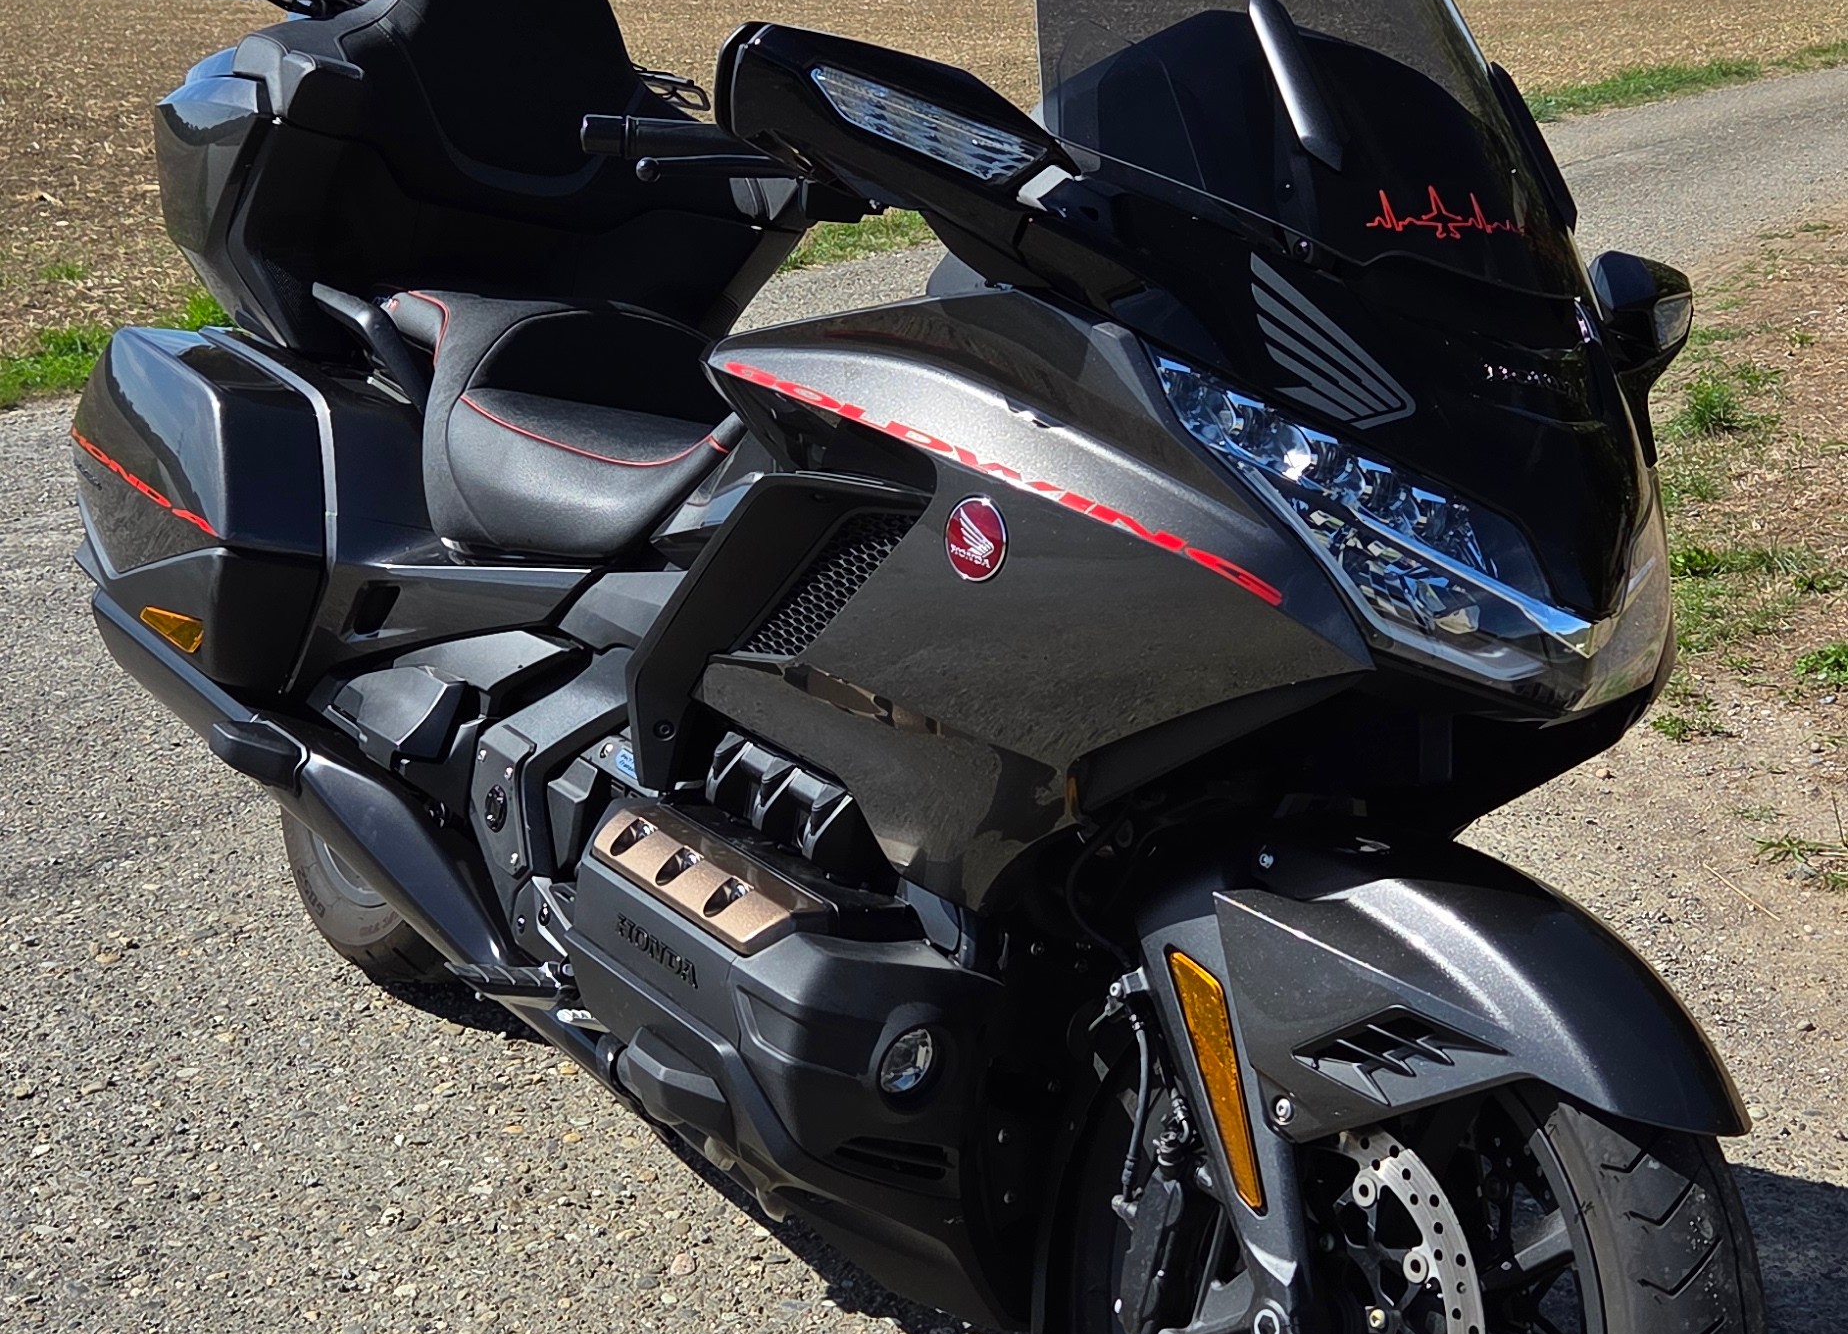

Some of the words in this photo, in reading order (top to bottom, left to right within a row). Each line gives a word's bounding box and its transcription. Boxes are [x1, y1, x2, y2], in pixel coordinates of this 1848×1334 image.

[724, 361, 1283, 607] GOLDWING
[950, 543, 991, 569] HONDA
[615, 913, 699, 990] HONDA
